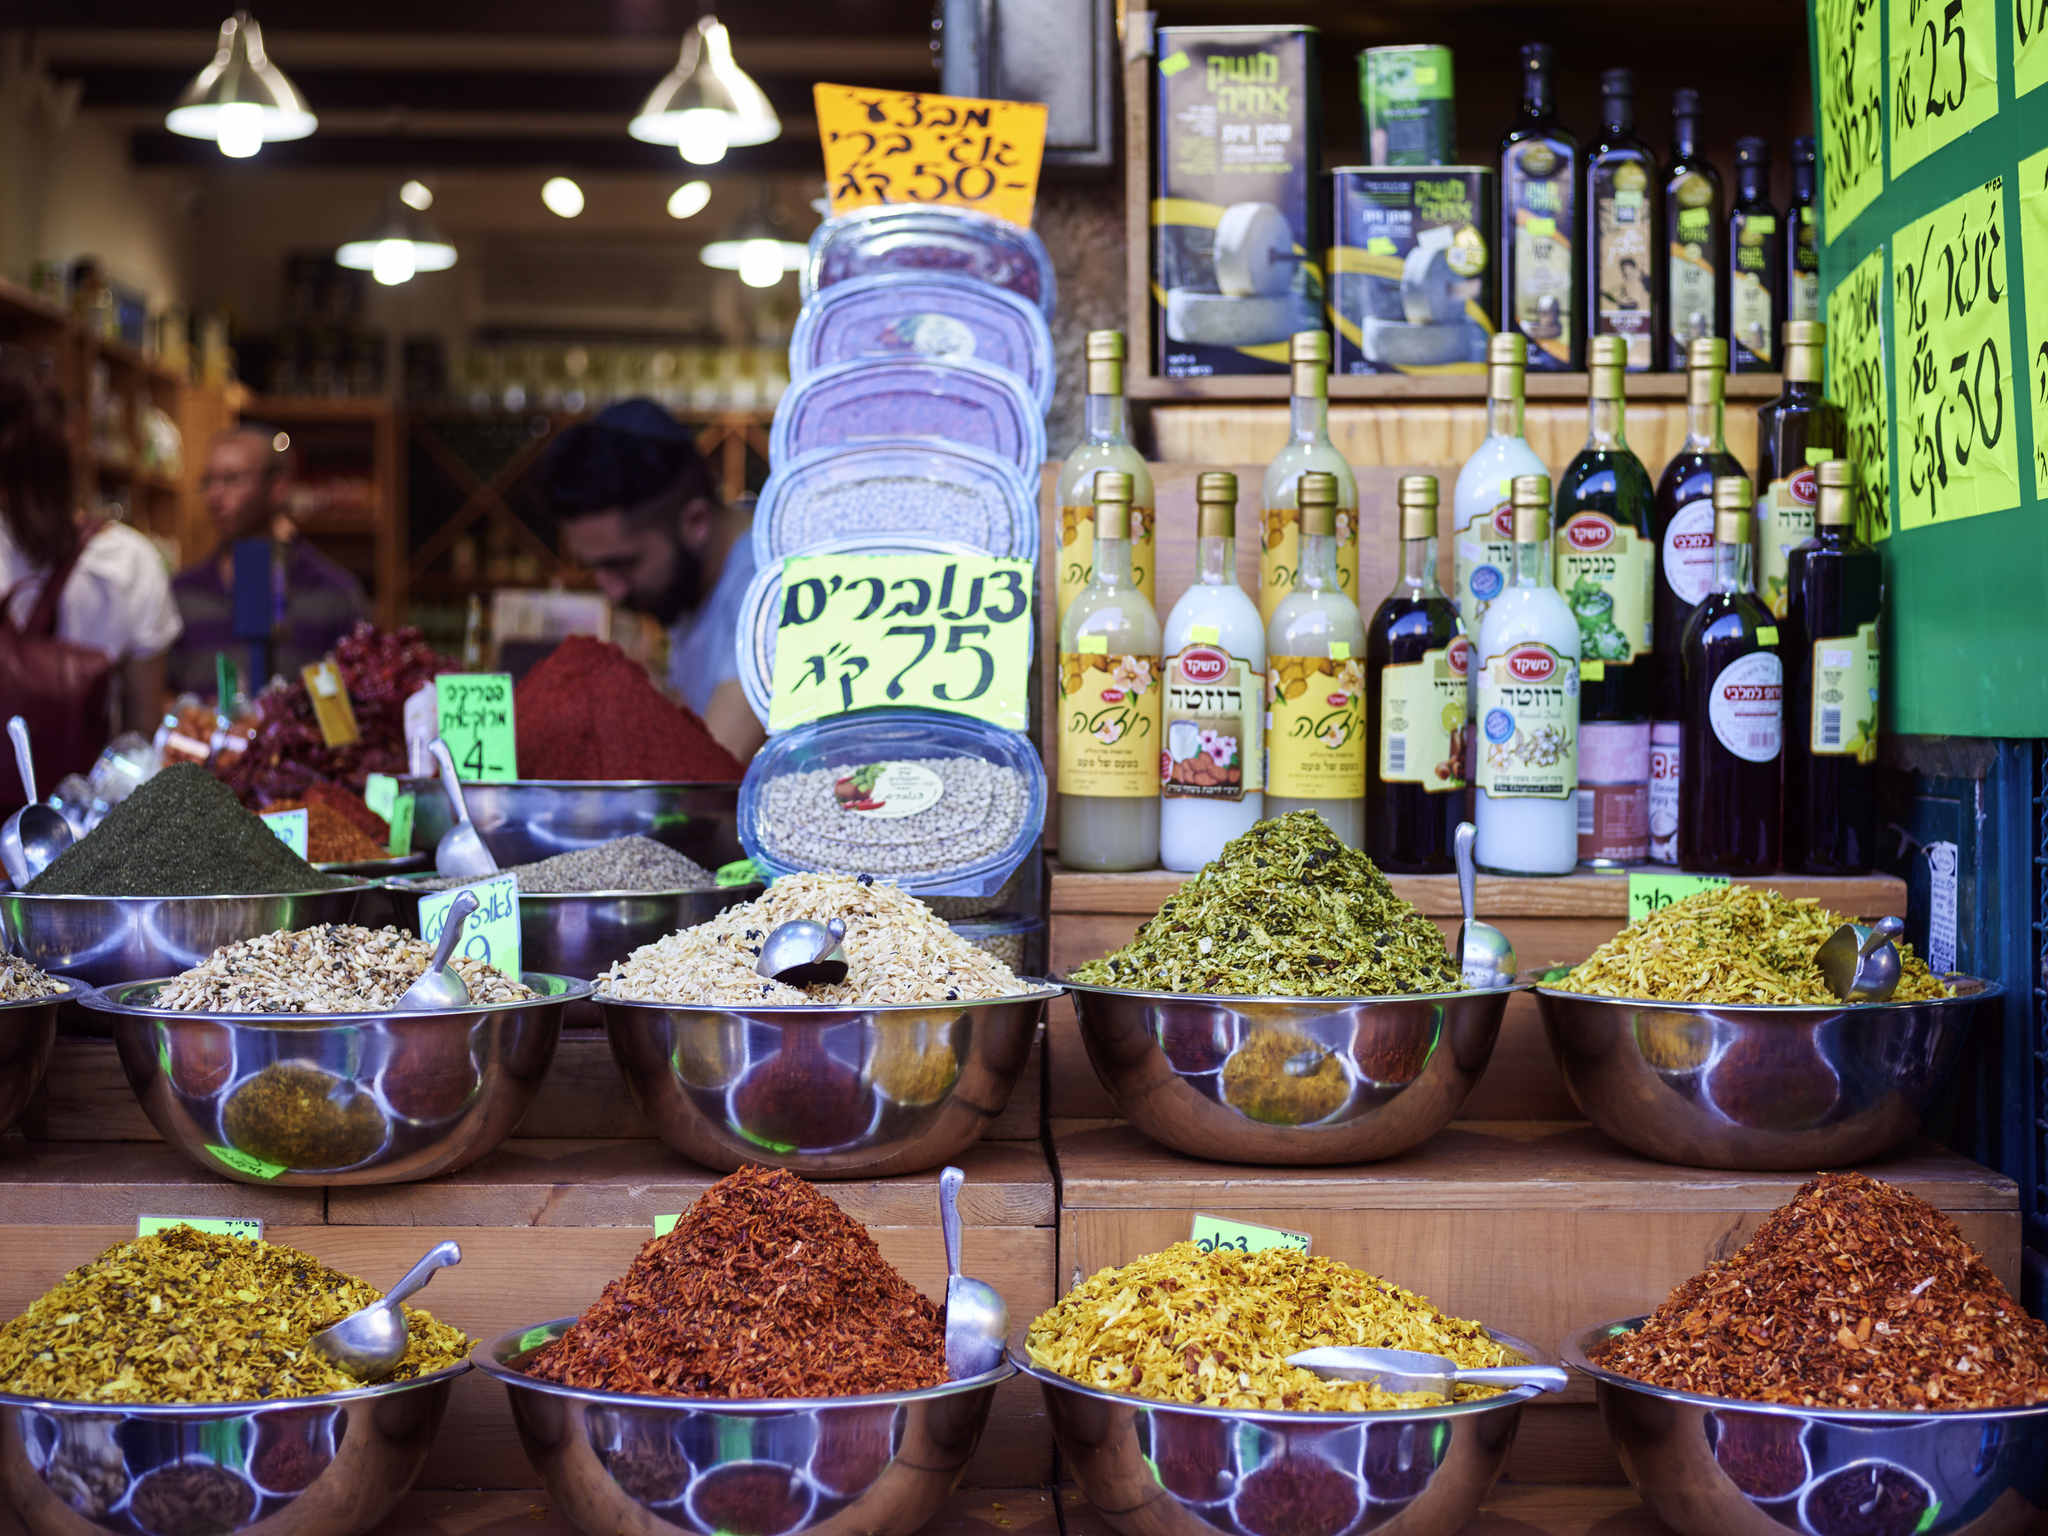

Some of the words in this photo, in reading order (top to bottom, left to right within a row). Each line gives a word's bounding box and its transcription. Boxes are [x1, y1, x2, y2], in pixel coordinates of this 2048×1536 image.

[1921, 0, 1967, 111] 25
[860, 96, 991, 128] מבצע
[1573, 527, 1606, 544] משקד
[1568, 556, 1616, 575] מנטה
[779, 564, 1027, 628] צנוברים
[885, 624, 994, 701] 75
[1185, 659, 1221, 675] משקד
[1513, 658, 1550, 674] משקד
[791, 642, 869, 711] ק"ג
[1170, 688, 1242, 710] רוזטה
[1500, 688, 1564, 706] רוזטה
[1070, 705, 1151, 746] רוזטה
